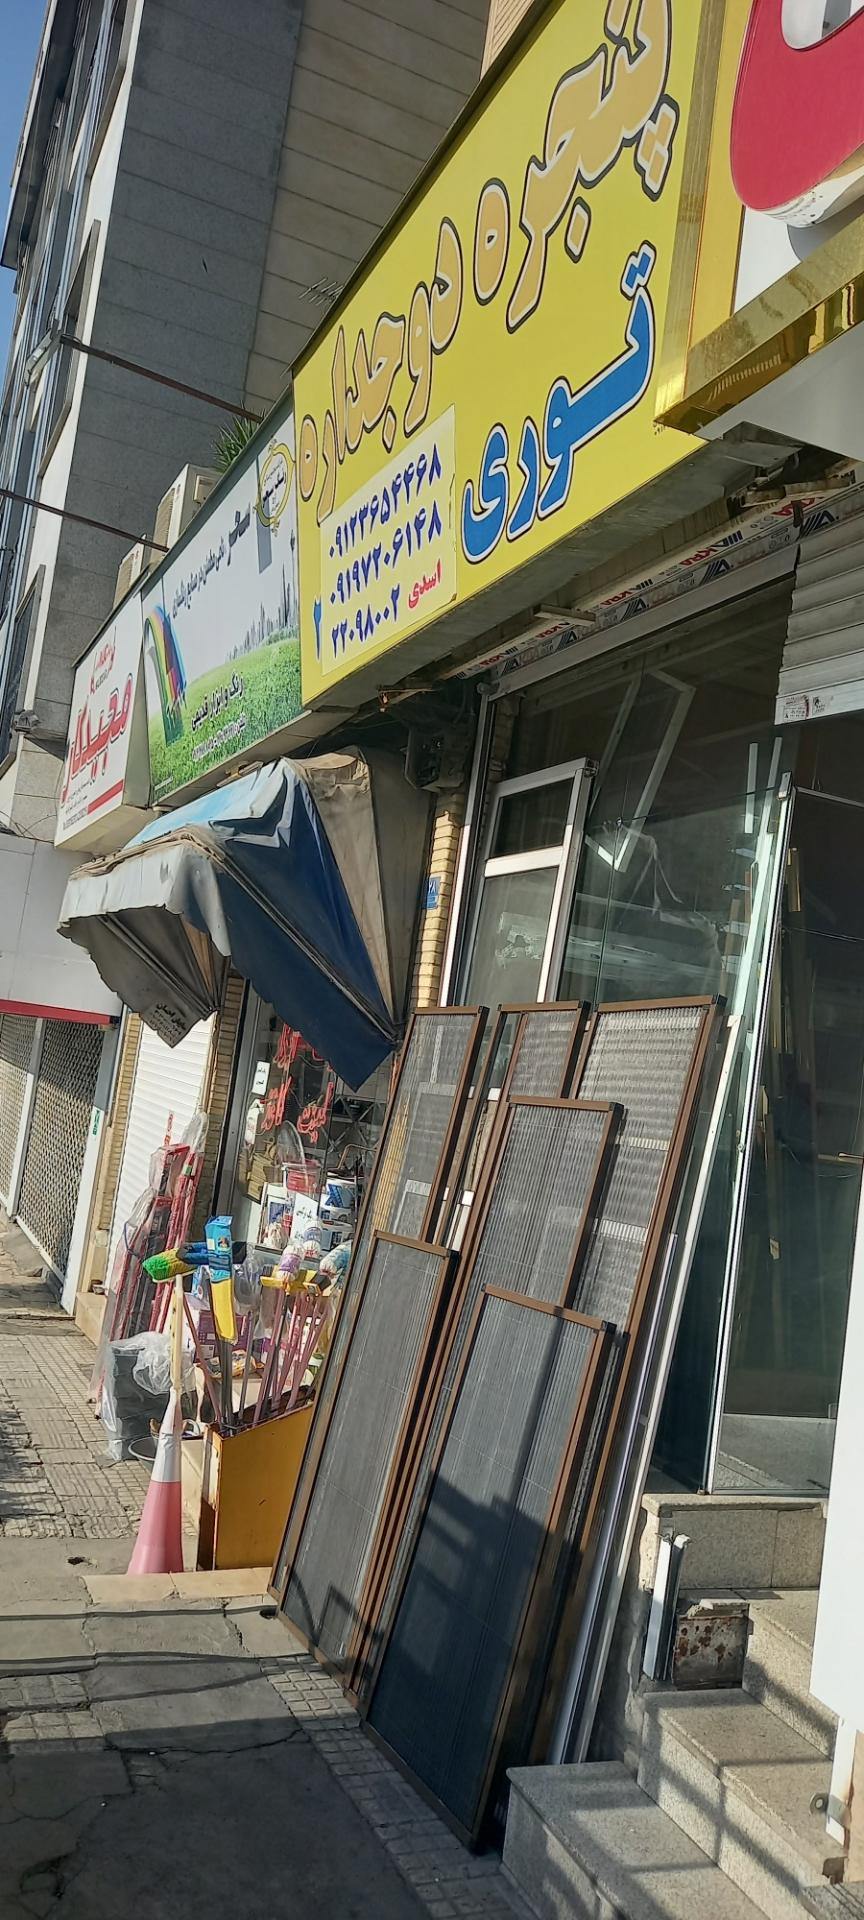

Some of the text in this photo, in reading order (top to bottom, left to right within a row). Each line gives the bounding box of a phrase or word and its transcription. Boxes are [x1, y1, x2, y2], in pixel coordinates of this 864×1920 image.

[461, 240, 656, 565] توری
[329, 443, 442, 558] ۰۹۱۲۳۶۵۴۴۶۸
[330, 500, 442, 605] ۰۹۱۹۷۲۰۶۱۴۸
[331, 559, 442, 659] اسدی ۲۲۰۹۸۰۰۲
